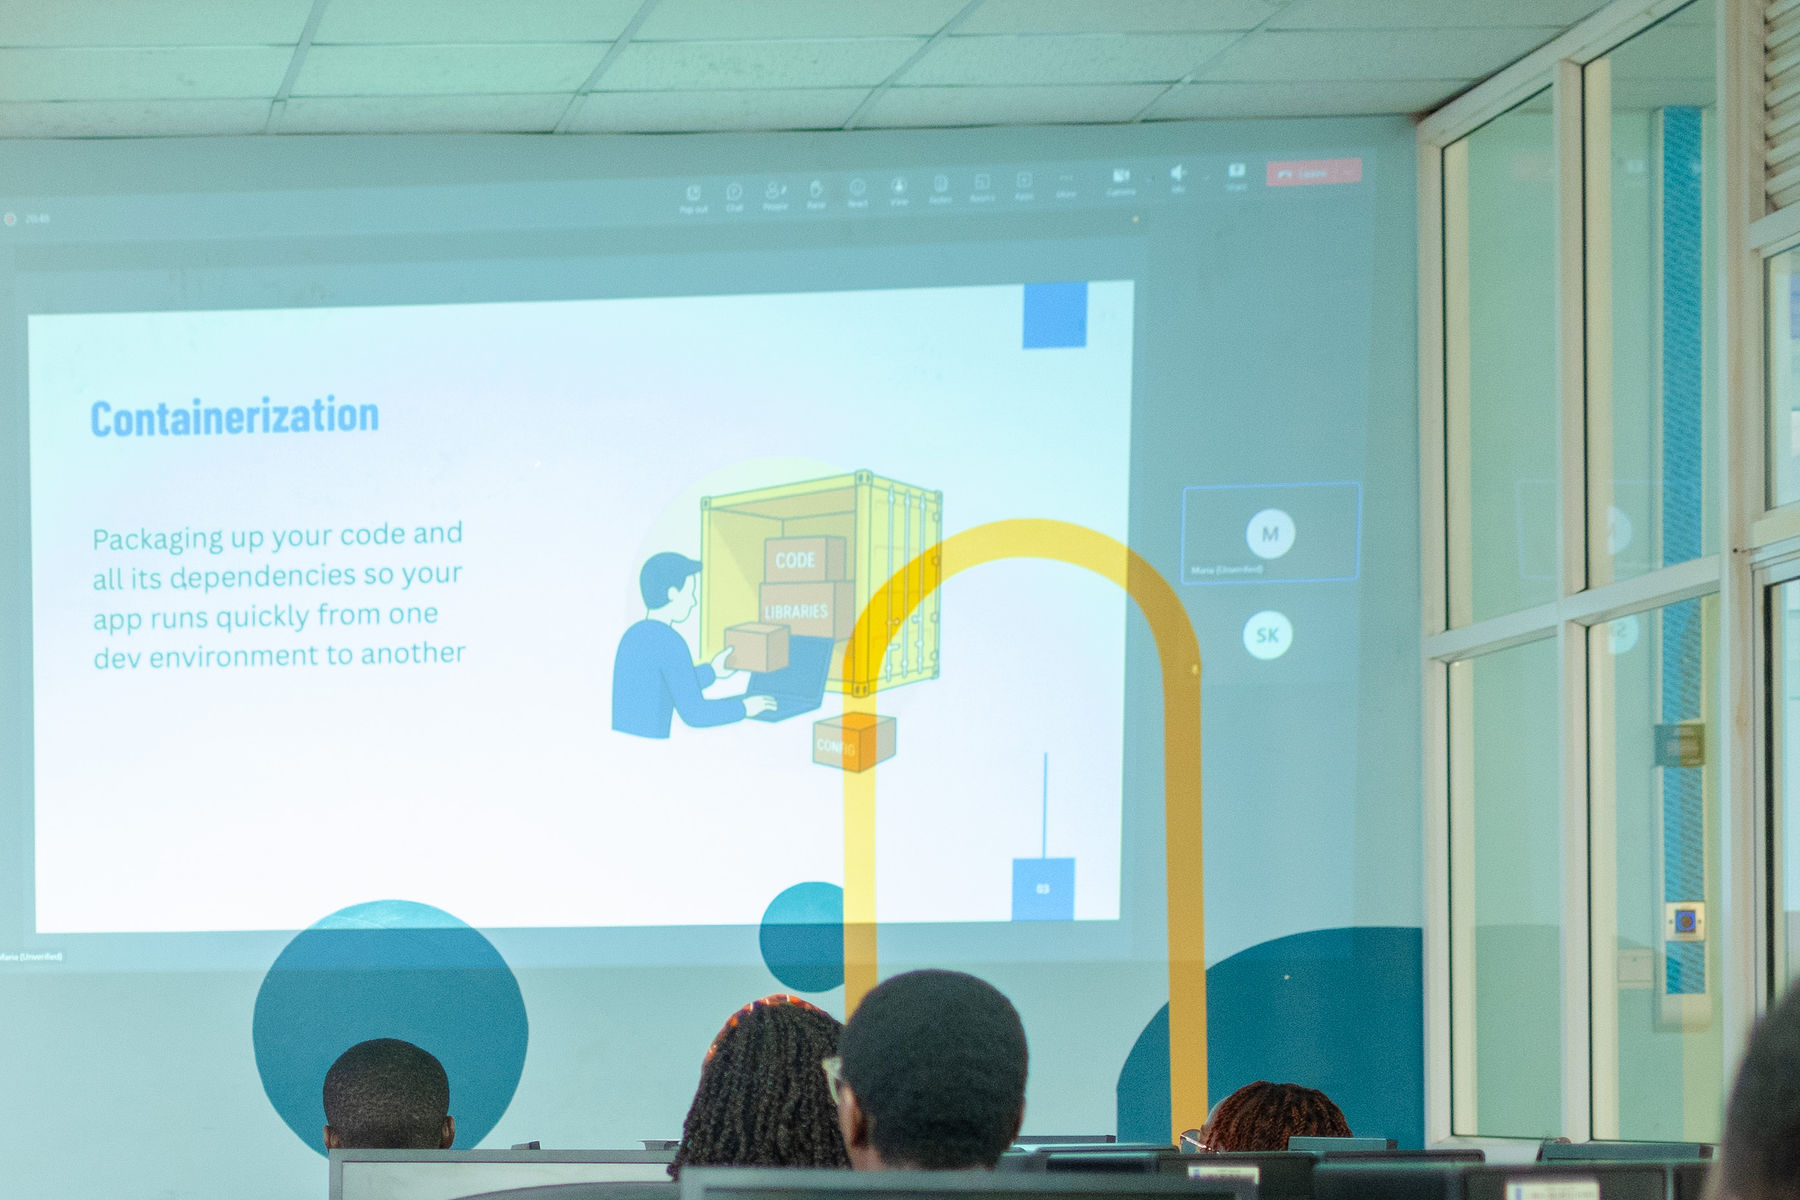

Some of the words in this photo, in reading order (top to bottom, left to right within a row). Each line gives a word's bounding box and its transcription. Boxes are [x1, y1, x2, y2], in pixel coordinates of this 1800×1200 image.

[91, 394, 378, 437] Containerization
[94, 526, 223, 556] Packaging
[231, 530, 264, 553] up
[272, 529, 333, 554] your
[340, 522, 405, 546] code
[414, 520, 462, 544] and
[1263, 526, 1279, 541] M
[776, 552, 815, 568] CODE
[93, 567, 123, 591] all
[132, 567, 162, 590] its
[170, 563, 356, 594] dependencies
[364, 567, 394, 585] so
[402, 566, 463, 590] your
[94, 613, 142, 636] app
[152, 611, 208, 629] runs
[216, 604, 309, 633] quickly
[318, 602, 380, 626] from
[389, 607, 438, 624] one
[765, 604, 828, 620] LIBRARIES
[1257, 628, 1279, 643] SK
[94, 647, 141, 670] dev
[150, 645, 318, 669] environment
[326, 645, 353, 665] to
[361, 641, 466, 665] another
